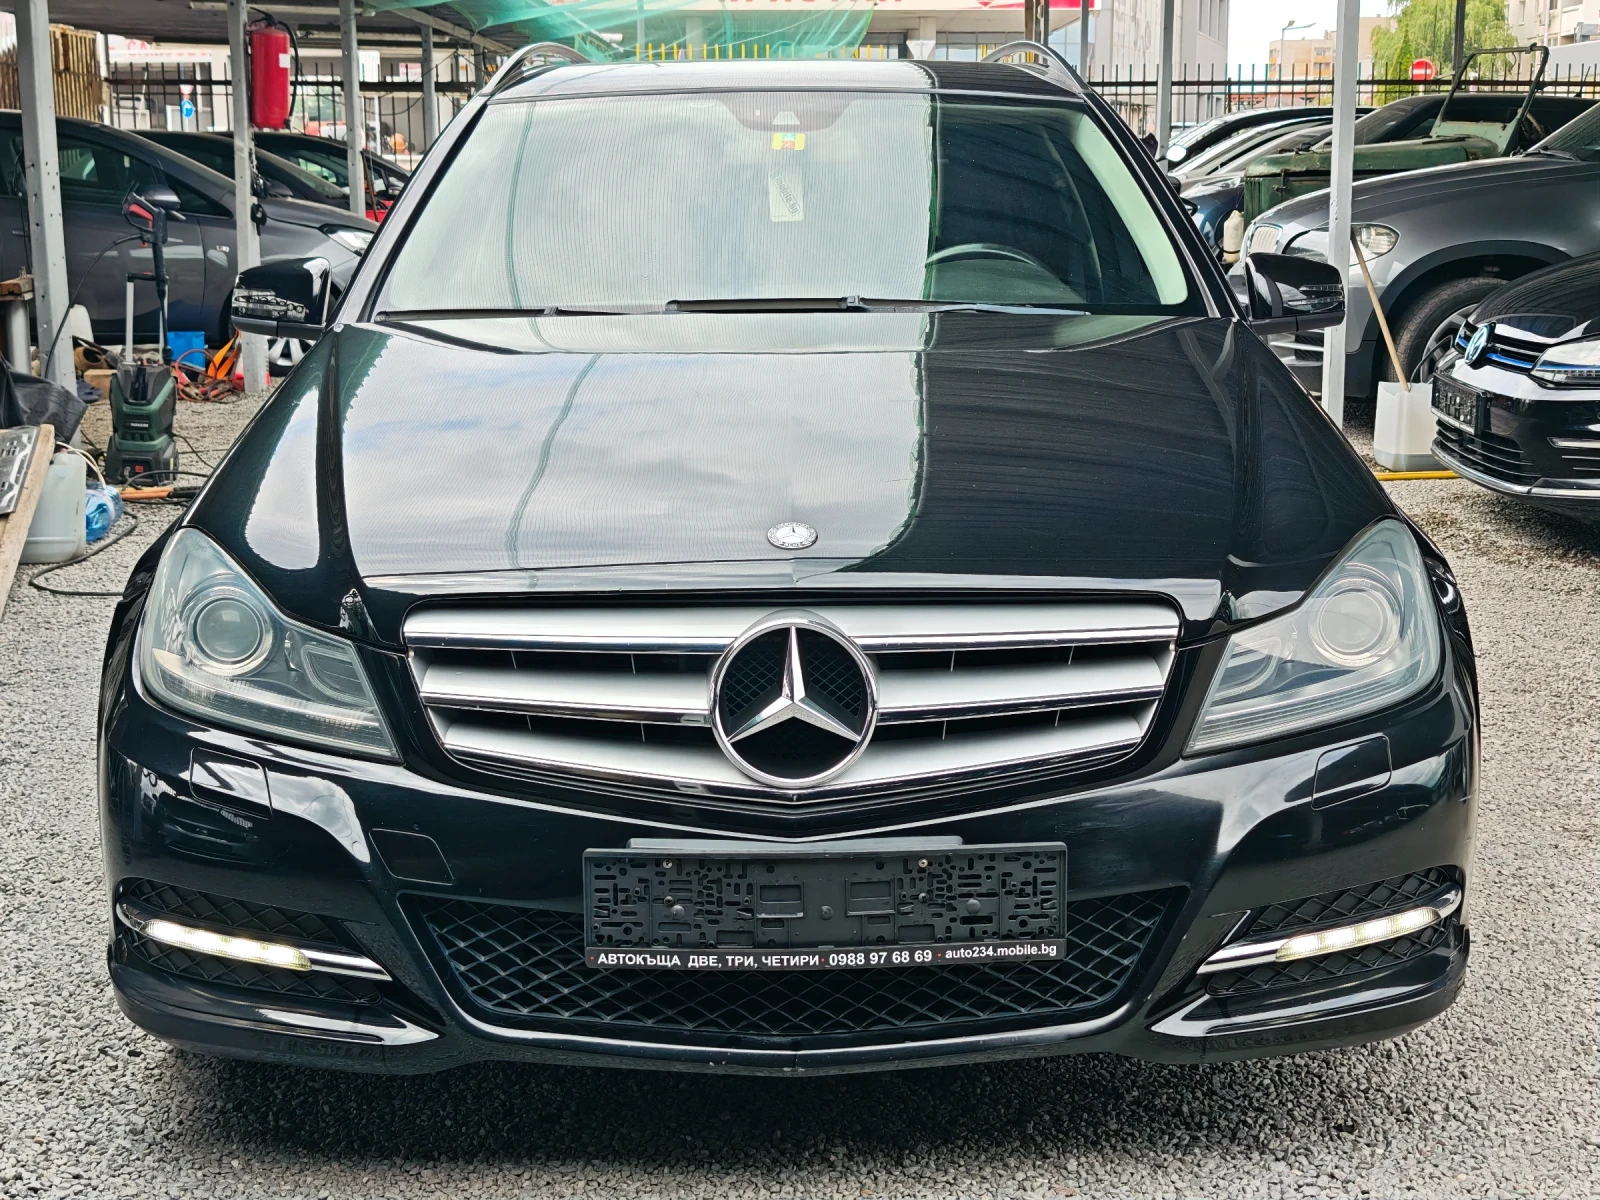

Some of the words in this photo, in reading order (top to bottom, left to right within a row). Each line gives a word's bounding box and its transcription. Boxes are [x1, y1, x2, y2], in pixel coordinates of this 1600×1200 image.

[598, 953, 681, 967] АВТОКЪЩА
[688, 955, 721, 968] ДВЕ,
[726, 955, 757, 968] ТРИ,
[762, 955, 819, 966] ЧЕТИРИ
[829, 952, 865, 966] 0988
[869, 952, 887, 964] 97
[892, 951, 909, 963] 68
[914, 950, 932, 962] 69
[945, 943, 1057, 958] auto234.mobile.bg
